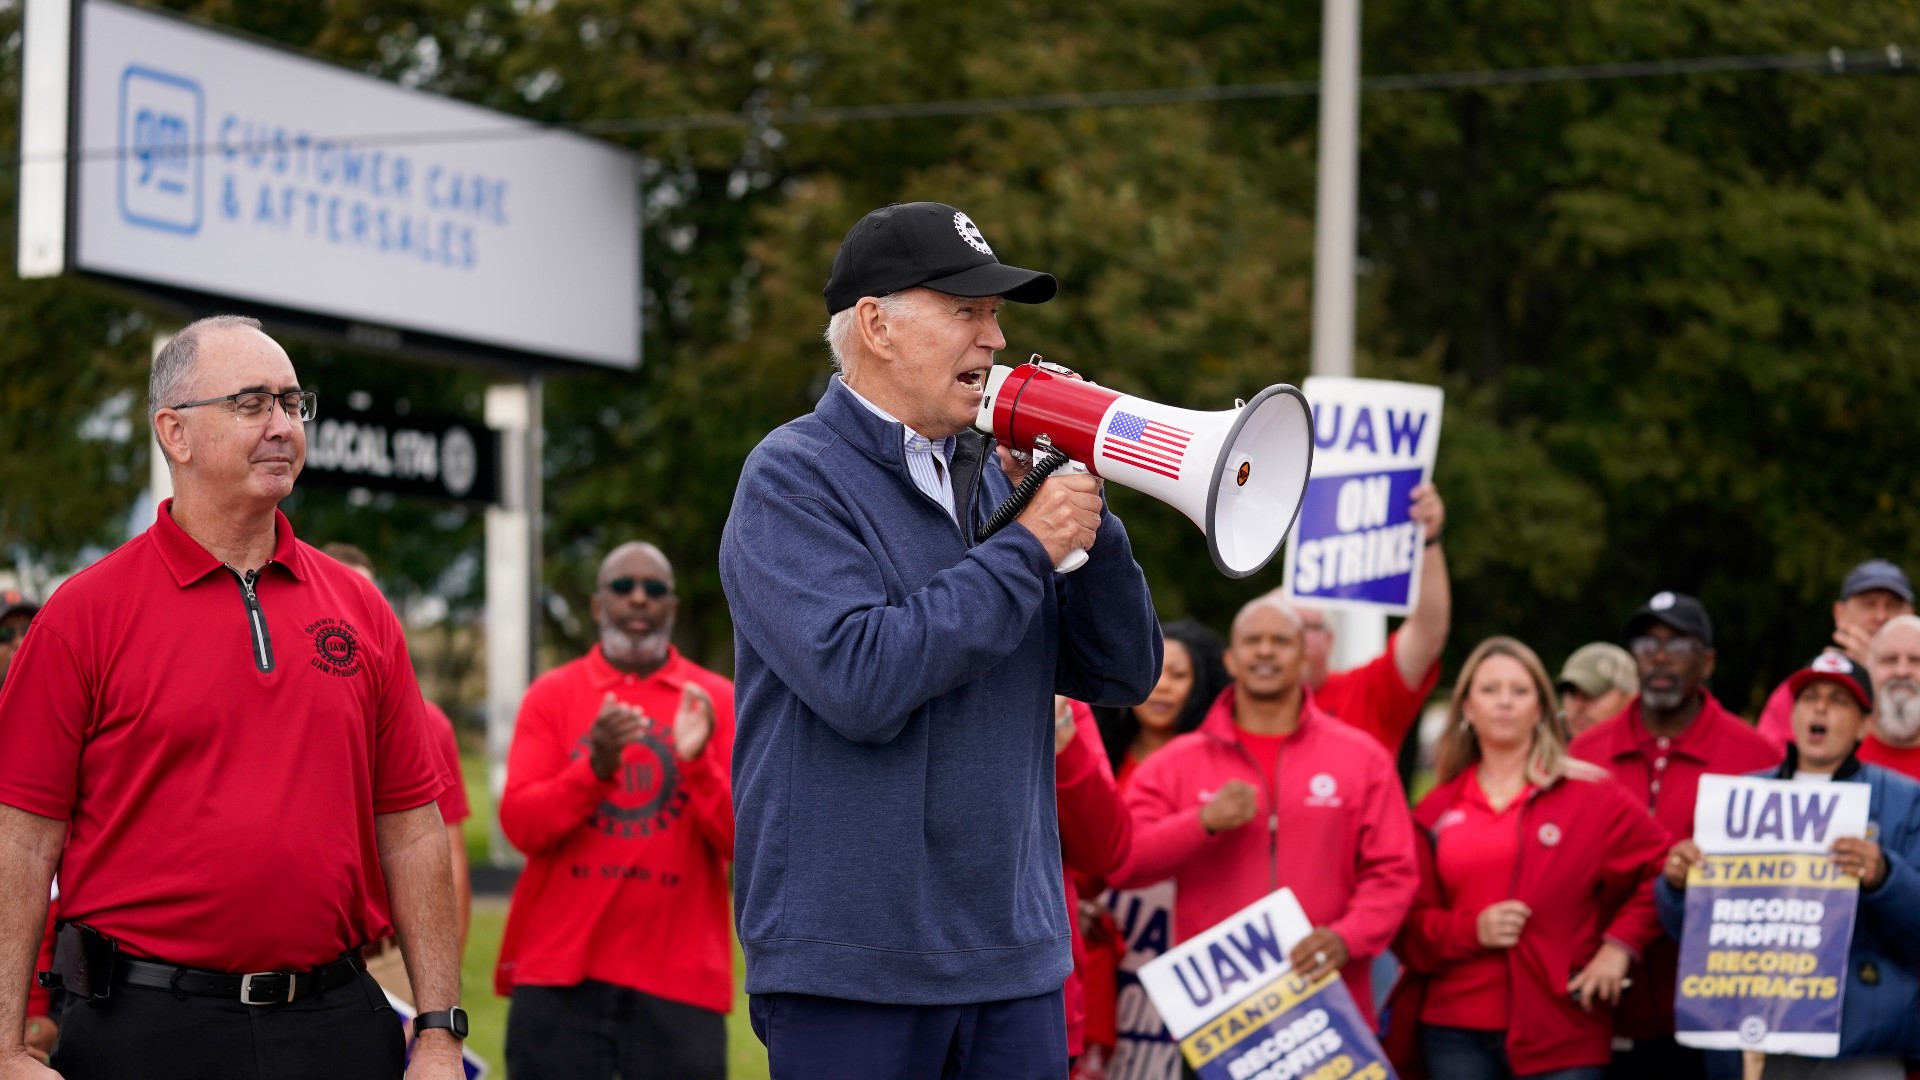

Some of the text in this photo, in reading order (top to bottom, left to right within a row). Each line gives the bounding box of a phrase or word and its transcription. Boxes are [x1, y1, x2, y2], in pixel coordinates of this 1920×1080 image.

[134, 109, 188, 186] gm
[219, 113, 511, 226] CUSTOMER CARE
[221, 172, 477, 269] & AFTERSALES
[1313, 403, 1428, 457] UAW
[1337, 475, 1390, 532] ON
[1295, 521, 1415, 594] STRIKE
[311, 657, 330, 674] UAW
[1725, 788, 1840, 843] UAW
[1701, 860, 1797, 880] STAND
[1709, 923, 1822, 949] PROFITS
[1712, 898, 1825, 923] RECORD
[1173, 911, 1283, 1008] UAW
[1681, 976, 1839, 999] CONTRACTS
[1706, 951, 1818, 975] RECORD
[1194, 991, 1282, 1056] STAND
[1227, 1007, 1330, 1080] RECORD
